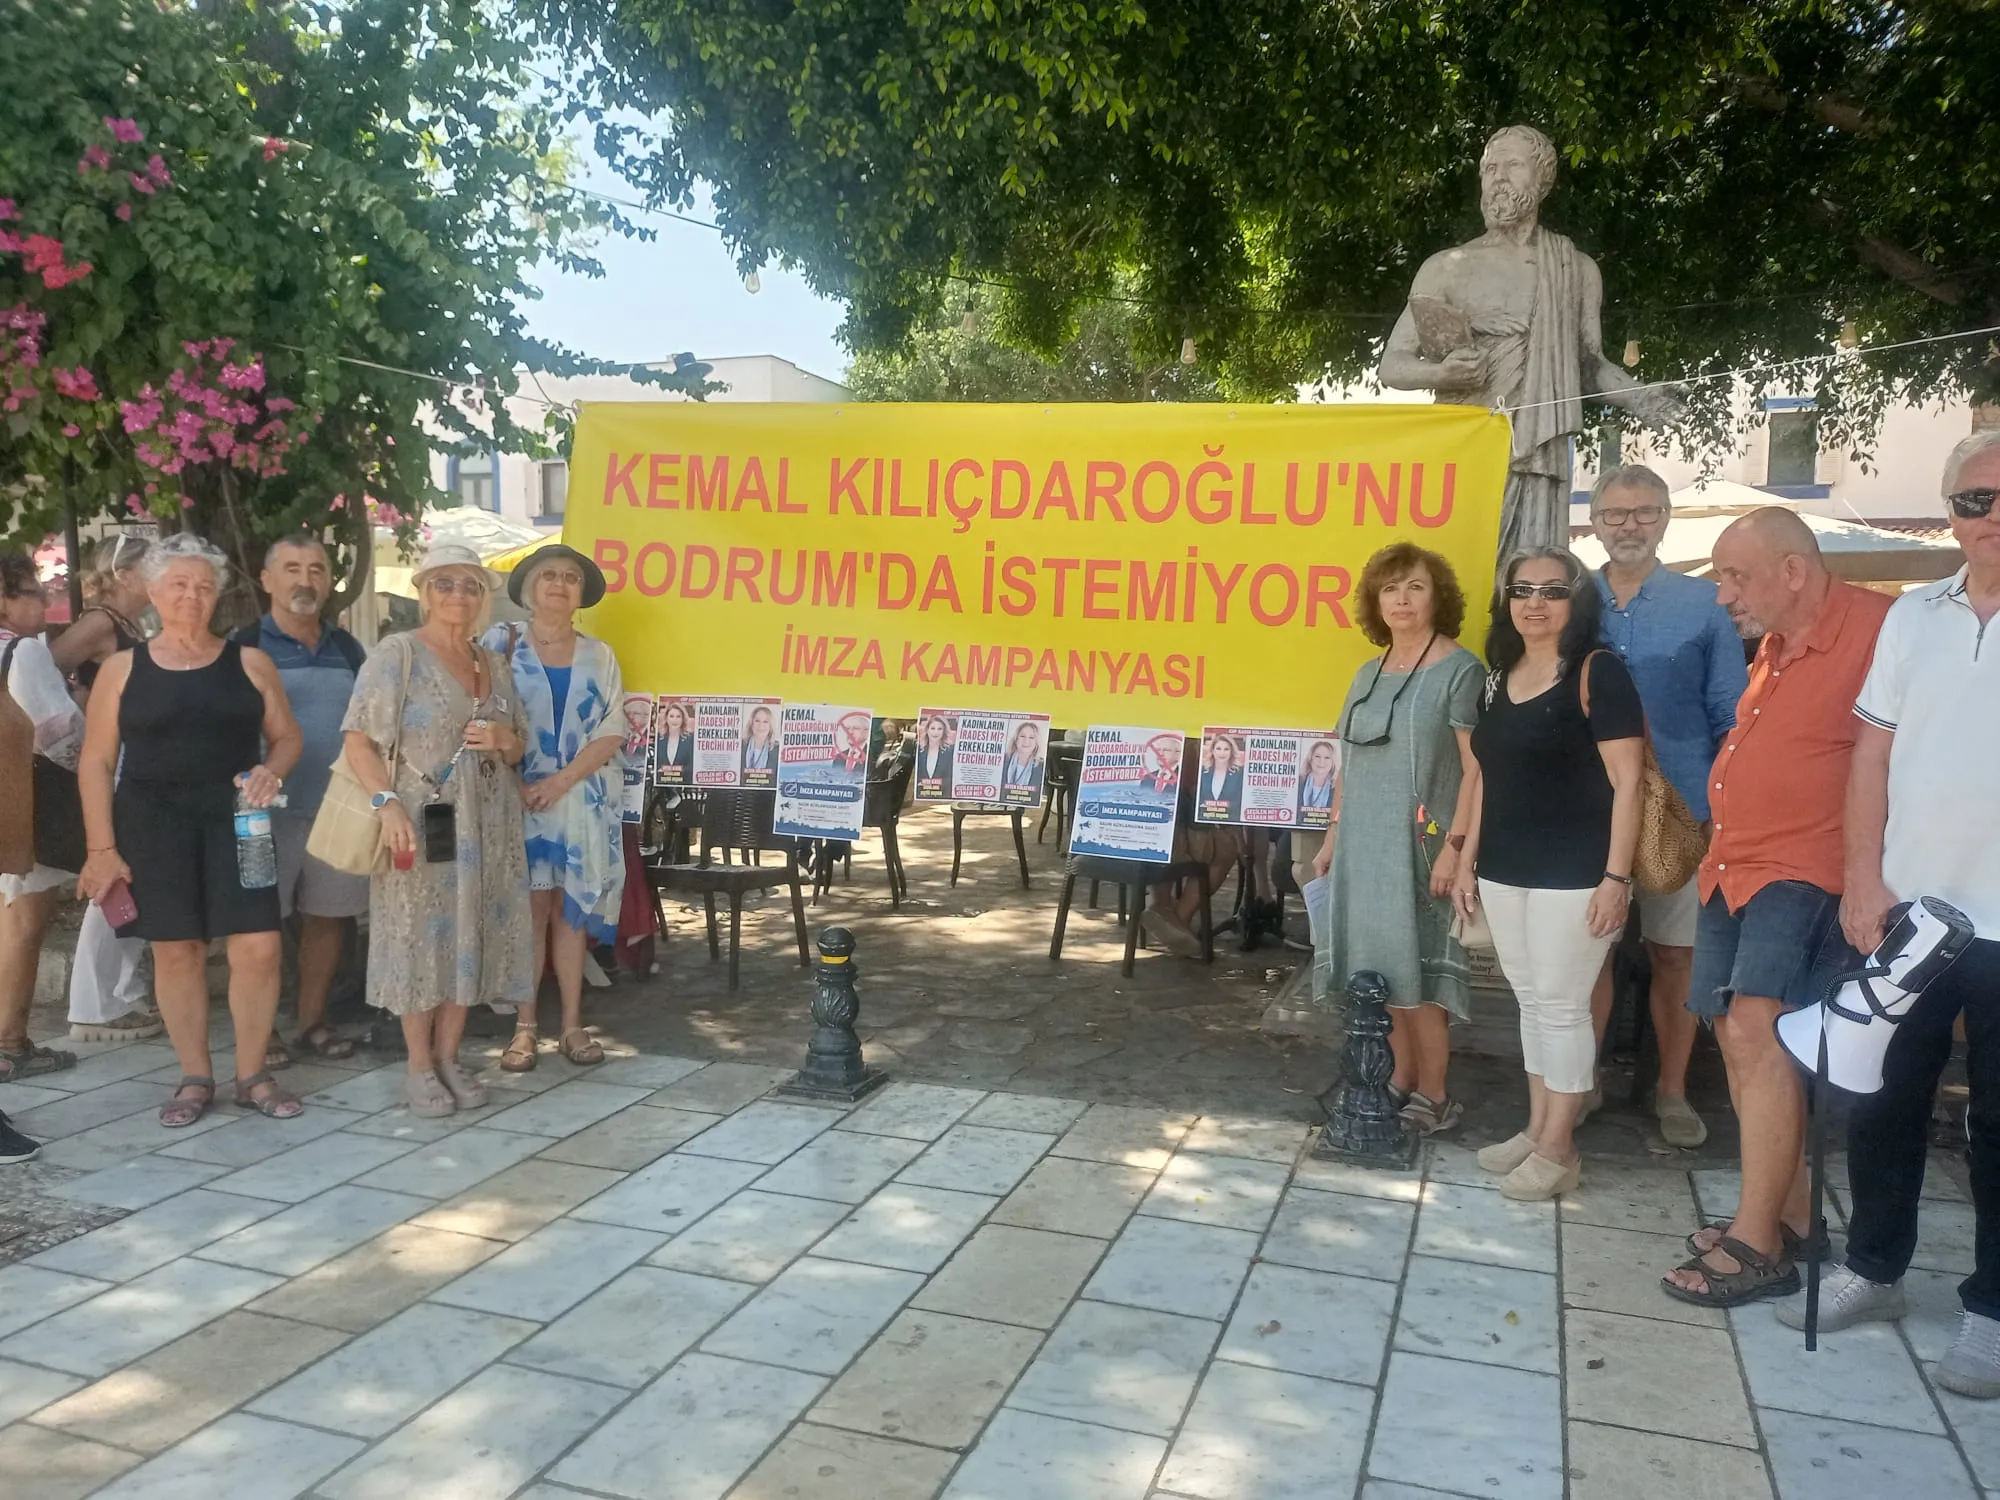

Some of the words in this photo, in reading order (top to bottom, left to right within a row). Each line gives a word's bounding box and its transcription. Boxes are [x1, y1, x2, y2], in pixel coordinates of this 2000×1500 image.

[603, 452, 809, 514] KEMAL
[829, 444, 1456, 533] KILIÇDAROĞLU'NU
[593, 538, 963, 614] BODRUM'DA
[982, 540, 1353, 628] İSTEMİYOR
[781, 623, 886, 680] İMZA
[900, 639, 1205, 699] KAMPANYASI
[699, 705, 739, 716] KADINLARIN
[785, 708, 816, 721] KEMAL
[962, 719, 1004, 731] KADINLARIN
[698, 728, 739, 740] ERKEKLERİN
[784, 734, 833, 746] BODRUM'DA
[1088, 730, 1122, 743] KEMAL
[958, 741, 1002, 754] ERKEKLERİN
[1250, 738, 1296, 750] KADINLARIN
[785, 747, 833, 761] İSTEMİYORUZ
[1086, 754, 1141, 767] BODRUM'DA
[1249, 750, 1280, 760] İRADESİ
[1282, 751, 1296, 762] Mİ?
[1086, 768, 1140, 781] İSTEMİYORUZ
[1248, 762, 1296, 775] ERKEKLERİN
[1248, 774, 1280, 786] TERCİHİ
[1281, 776, 1296, 788] Mİ?
[800, 786, 814, 795] İMZA
[814, 788, 854, 798] KAMPANYASI
[1102, 806, 1118, 814] İMZA
[1118, 808, 1162, 818] KAMPANYASI
